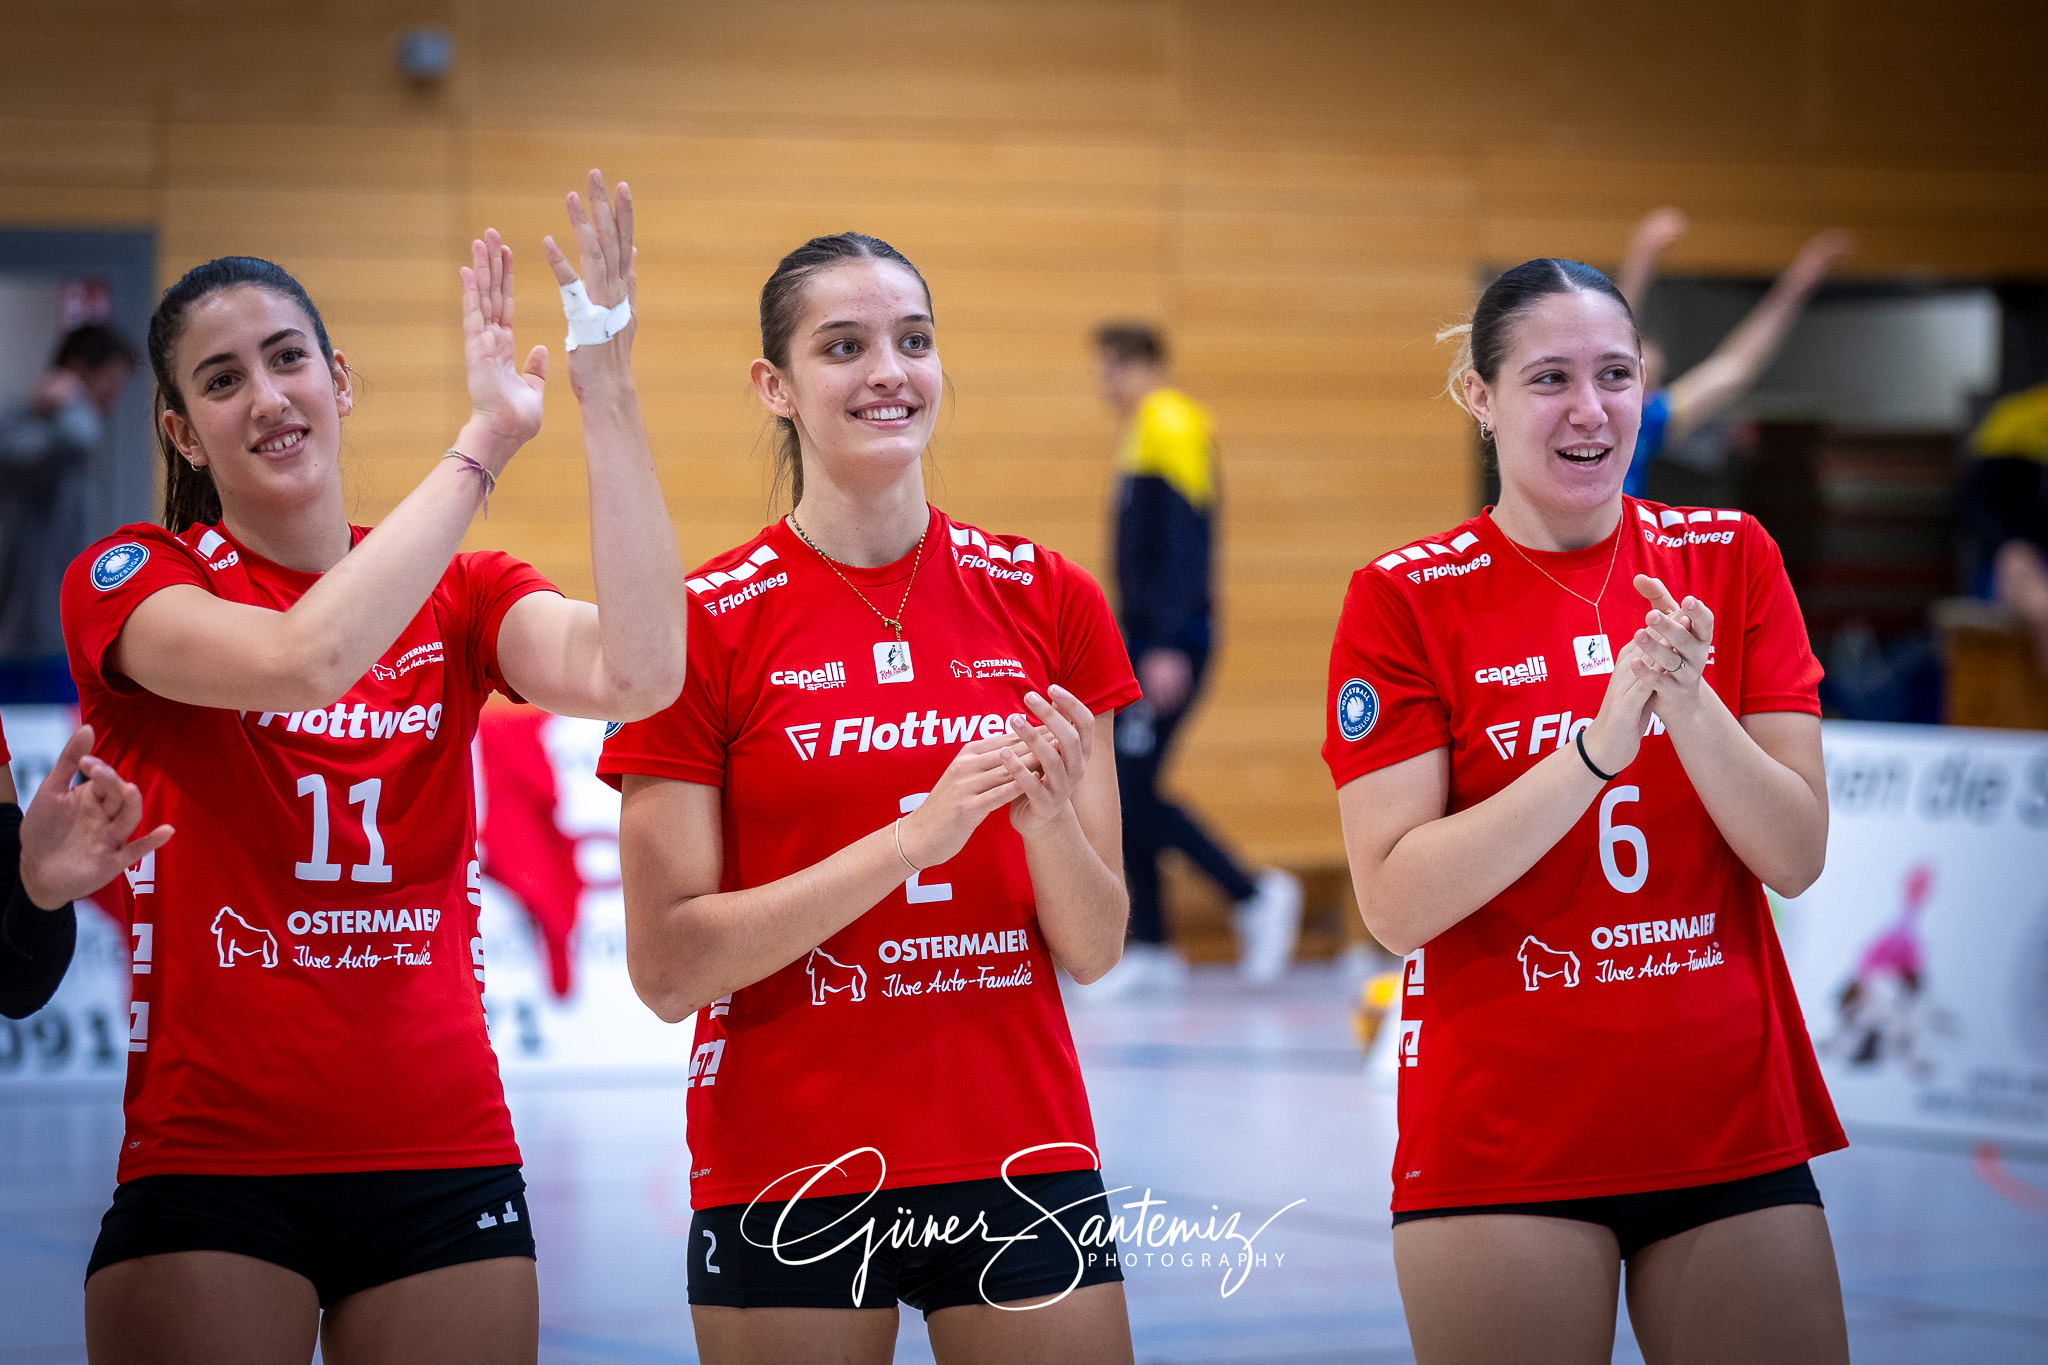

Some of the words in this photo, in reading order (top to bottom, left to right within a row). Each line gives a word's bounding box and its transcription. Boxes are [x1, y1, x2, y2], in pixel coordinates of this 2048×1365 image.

[1656, 530, 1735, 548] Flottweg
[1423, 553, 1491, 582] Flottweg
[718, 571, 789, 614] Flottweg
[395, 641, 444, 668] OSTERMAIER
[770, 661, 846, 690] capelli
[806, 680, 847, 691] SPORT
[1474, 655, 1548, 686] capelli
[1509, 674, 1548, 687] SPORT
[295, 773, 393, 883] 11
[1599, 785, 1649, 894] 6
[1591, 912, 1716, 950] OSTERMAIER
[292, 945, 332, 970] Ihre
[878, 929, 1029, 964] OSTERMAIER
[882, 973, 923, 997] Ihre
[925, 962, 1033, 994] Auto-Familie
[1595, 959, 1635, 983] Ihre
[702, 1229, 721, 1274] 2
